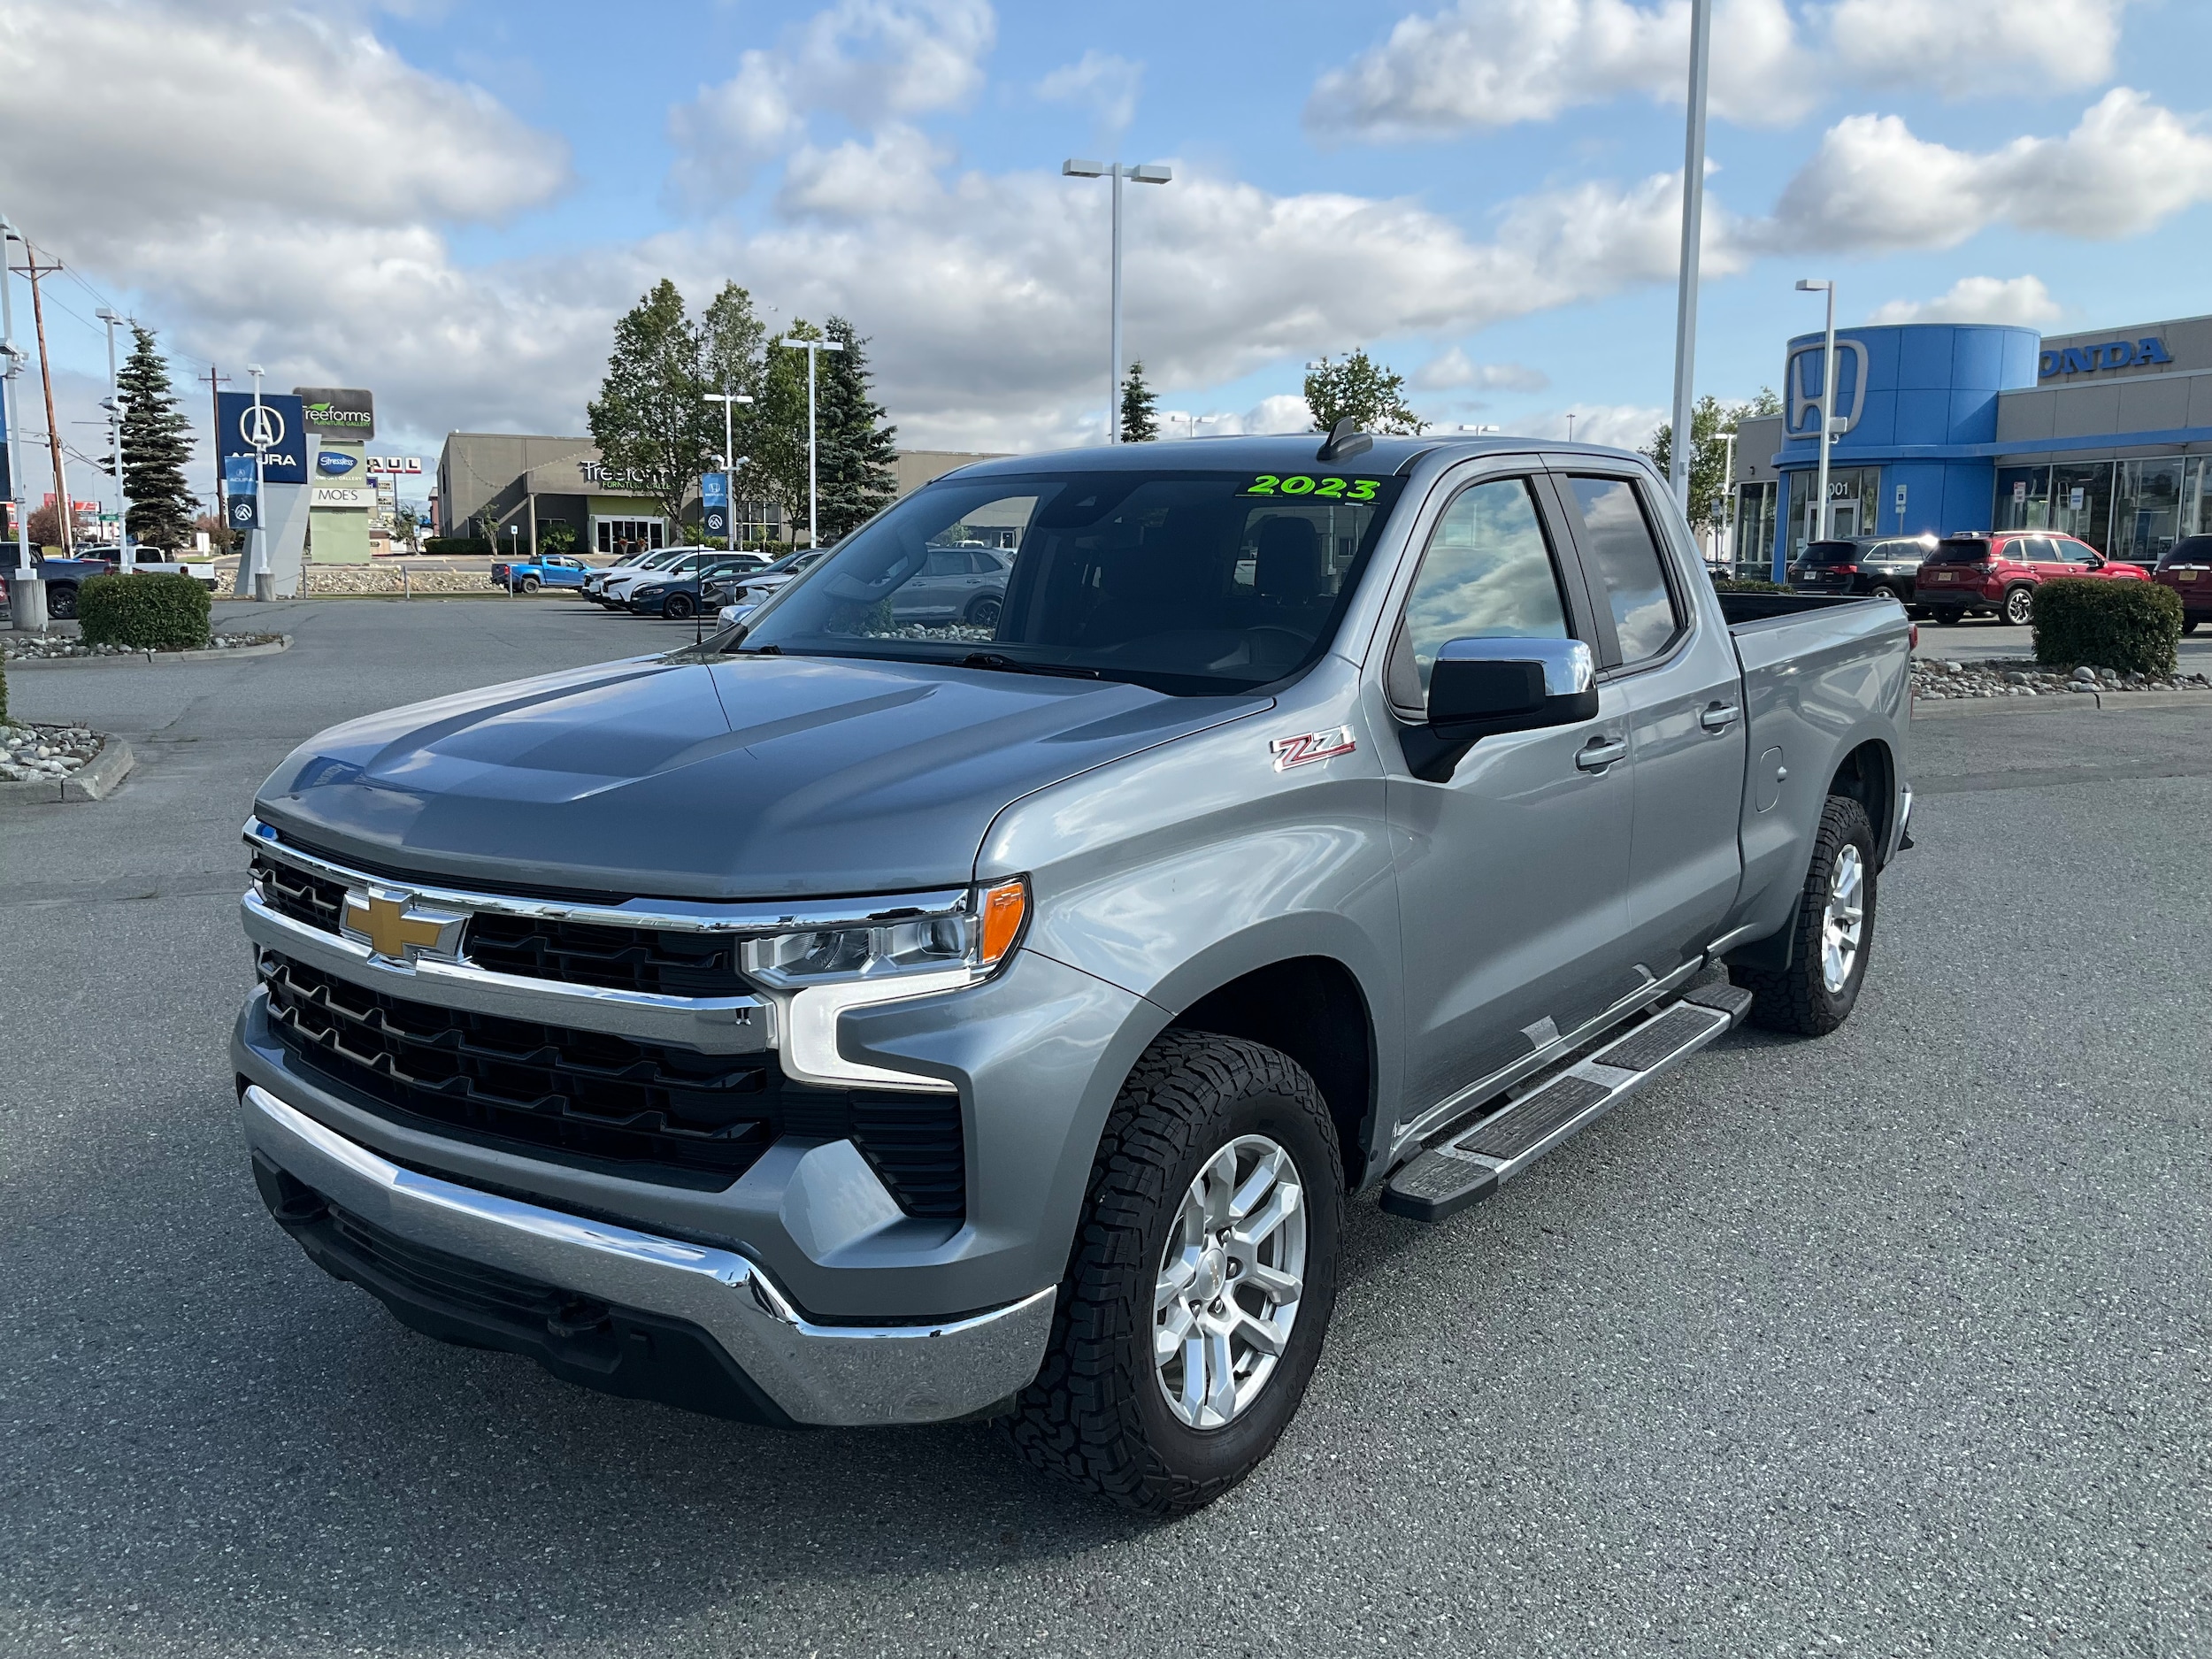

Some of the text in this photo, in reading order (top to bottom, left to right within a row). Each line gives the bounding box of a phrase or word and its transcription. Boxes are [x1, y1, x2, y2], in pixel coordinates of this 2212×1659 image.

[2039, 336, 2170, 378] ONDA
[320, 457, 354, 466] Stressless
[319, 489, 358, 501] MOE'S
[1247, 474, 1381, 502] 2023
[1269, 723, 1356, 772] Z71
